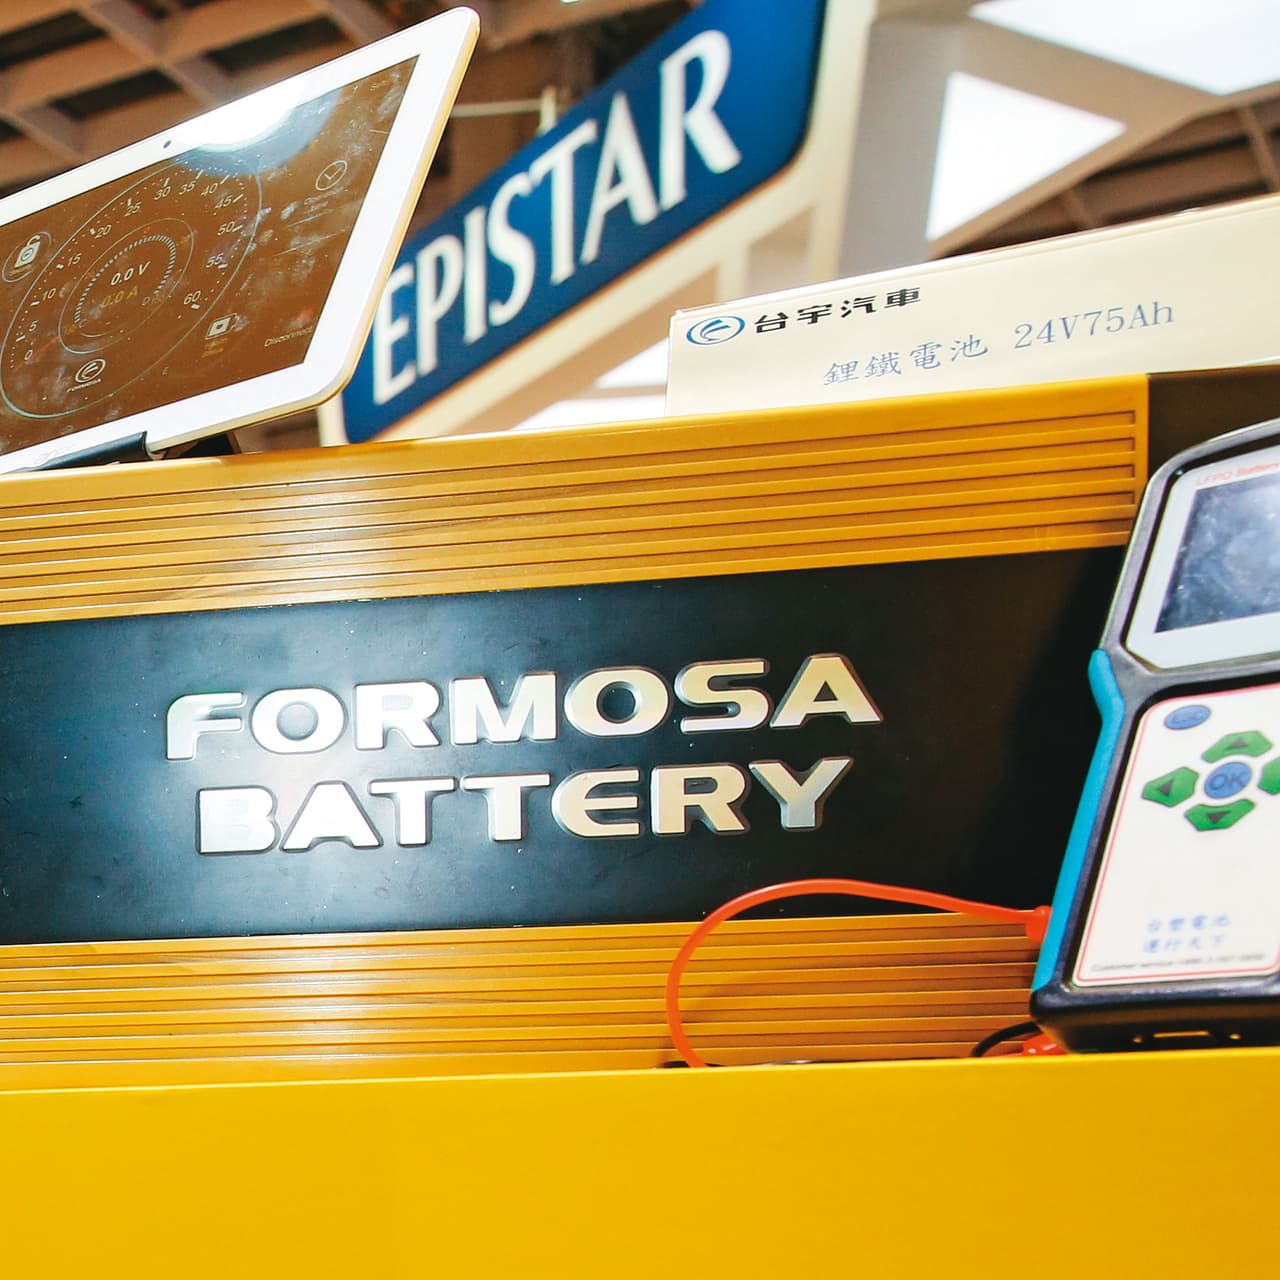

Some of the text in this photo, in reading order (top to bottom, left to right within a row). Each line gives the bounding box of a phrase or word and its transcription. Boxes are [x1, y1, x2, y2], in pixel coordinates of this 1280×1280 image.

[154, 186, 171, 200] 30
[179, 182, 195, 195] 35
[201, 183, 218, 196] 40
[214, 195, 232, 209] 45
[370, 29, 741, 405] EPISTAR
[217, 221, 234, 235] 50
[67, 254, 81, 266] 15
[111, 261, 151, 286] 0.0 V
[43, 288, 56, 301] 10
[184, 291, 201, 304] 60
[754, 287, 921, 336] 台宇汽車
[823, 300, 1175, 387] 鋰鐵電池 24V75Ah
[166, 654, 883, 761] FORMOSA
[196, 756, 853, 855] BATTERY
